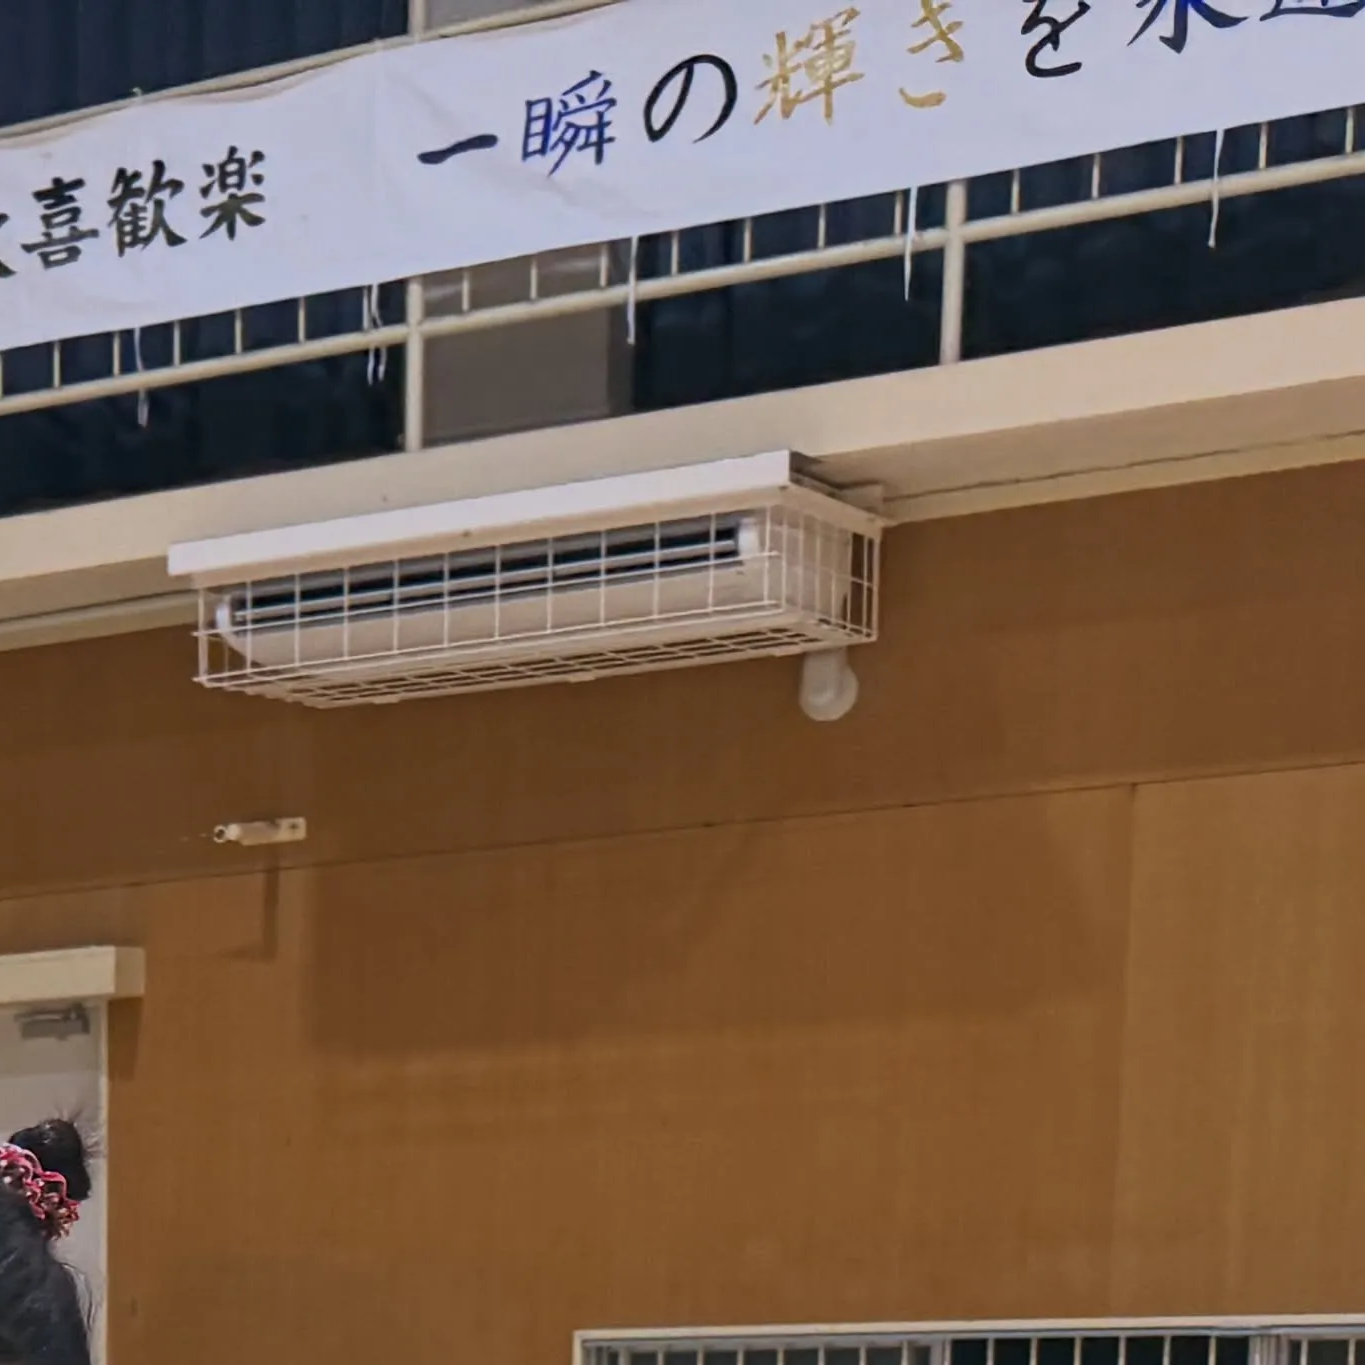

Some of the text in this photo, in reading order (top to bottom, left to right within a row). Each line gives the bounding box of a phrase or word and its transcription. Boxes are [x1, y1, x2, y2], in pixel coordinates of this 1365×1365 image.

[417, 0, 1365, 177] 一瞬の輝きを
